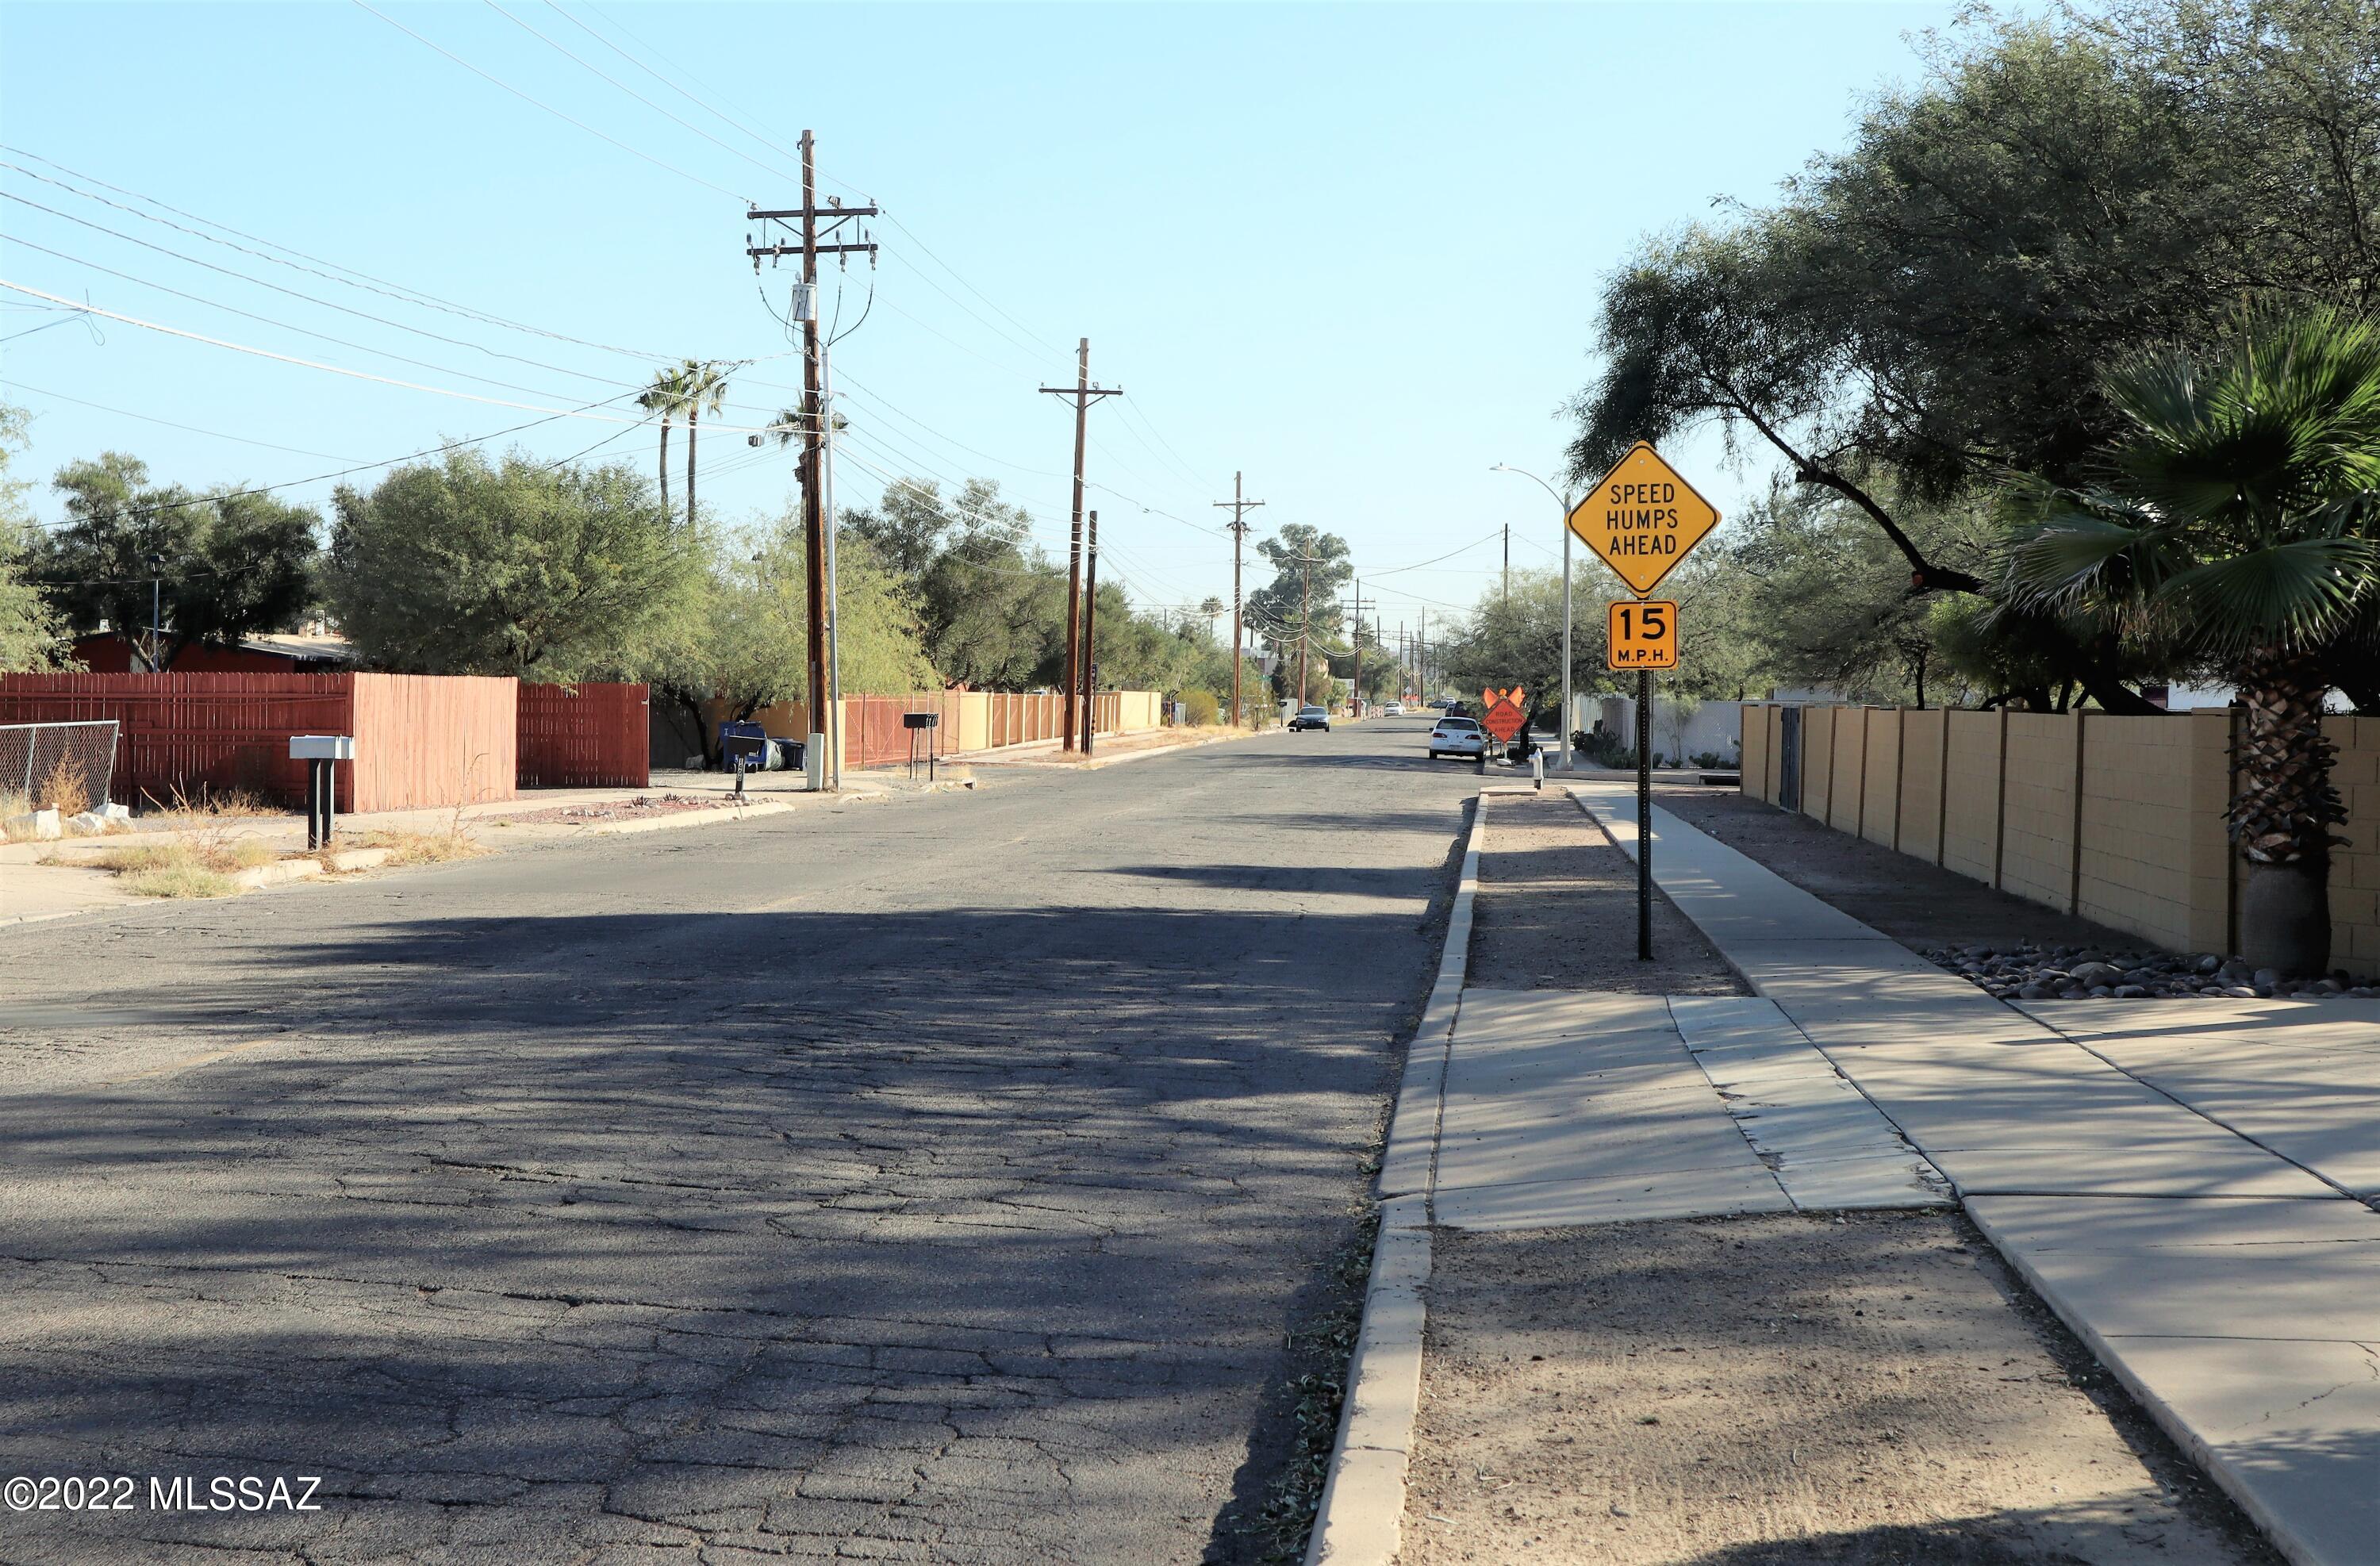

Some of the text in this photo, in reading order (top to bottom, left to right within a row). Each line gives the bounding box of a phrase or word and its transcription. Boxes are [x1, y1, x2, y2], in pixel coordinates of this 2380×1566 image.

[1610, 483, 1675, 505] SPEED
[1606, 509, 1678, 530] HUMPS
[1609, 535, 1676, 555] AHEAD
[1620, 608, 1666, 640] 15
[1618, 650, 1668, 662] M.P.H.
